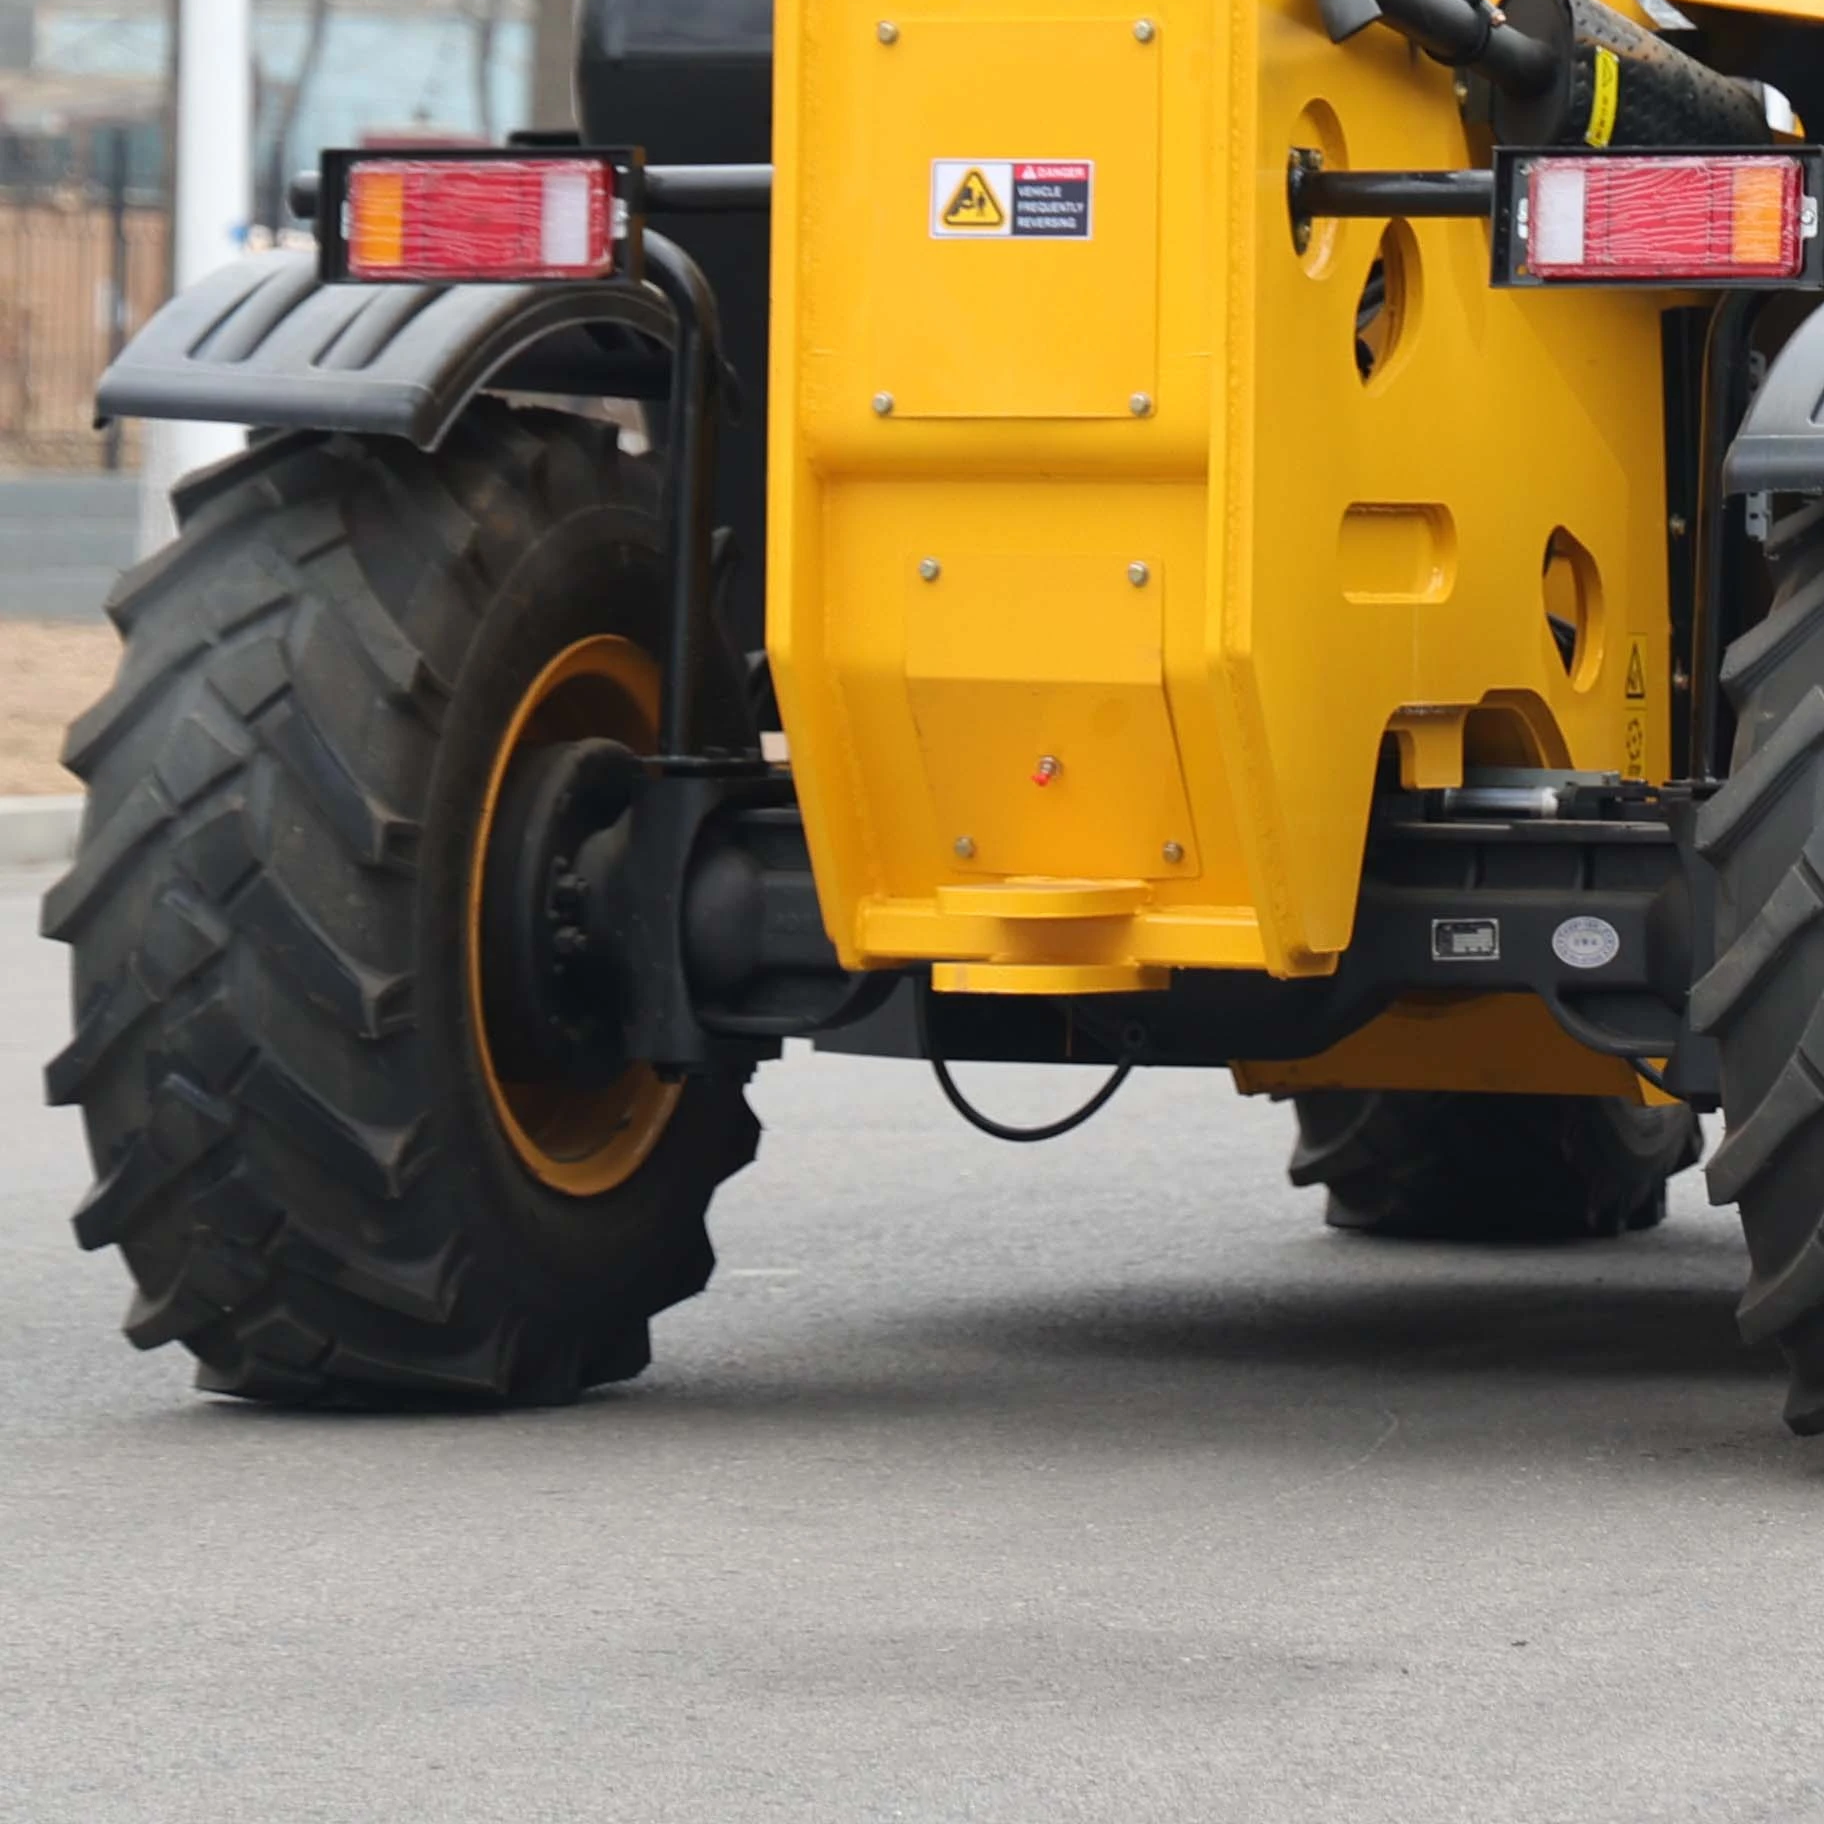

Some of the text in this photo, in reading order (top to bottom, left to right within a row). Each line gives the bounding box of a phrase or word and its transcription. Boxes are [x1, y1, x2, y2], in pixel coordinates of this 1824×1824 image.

[1036, 166, 1085, 178] DANGER
[1017, 185, 1062, 198] VEHICLE
[1017, 216, 1077, 229] REVERSING
